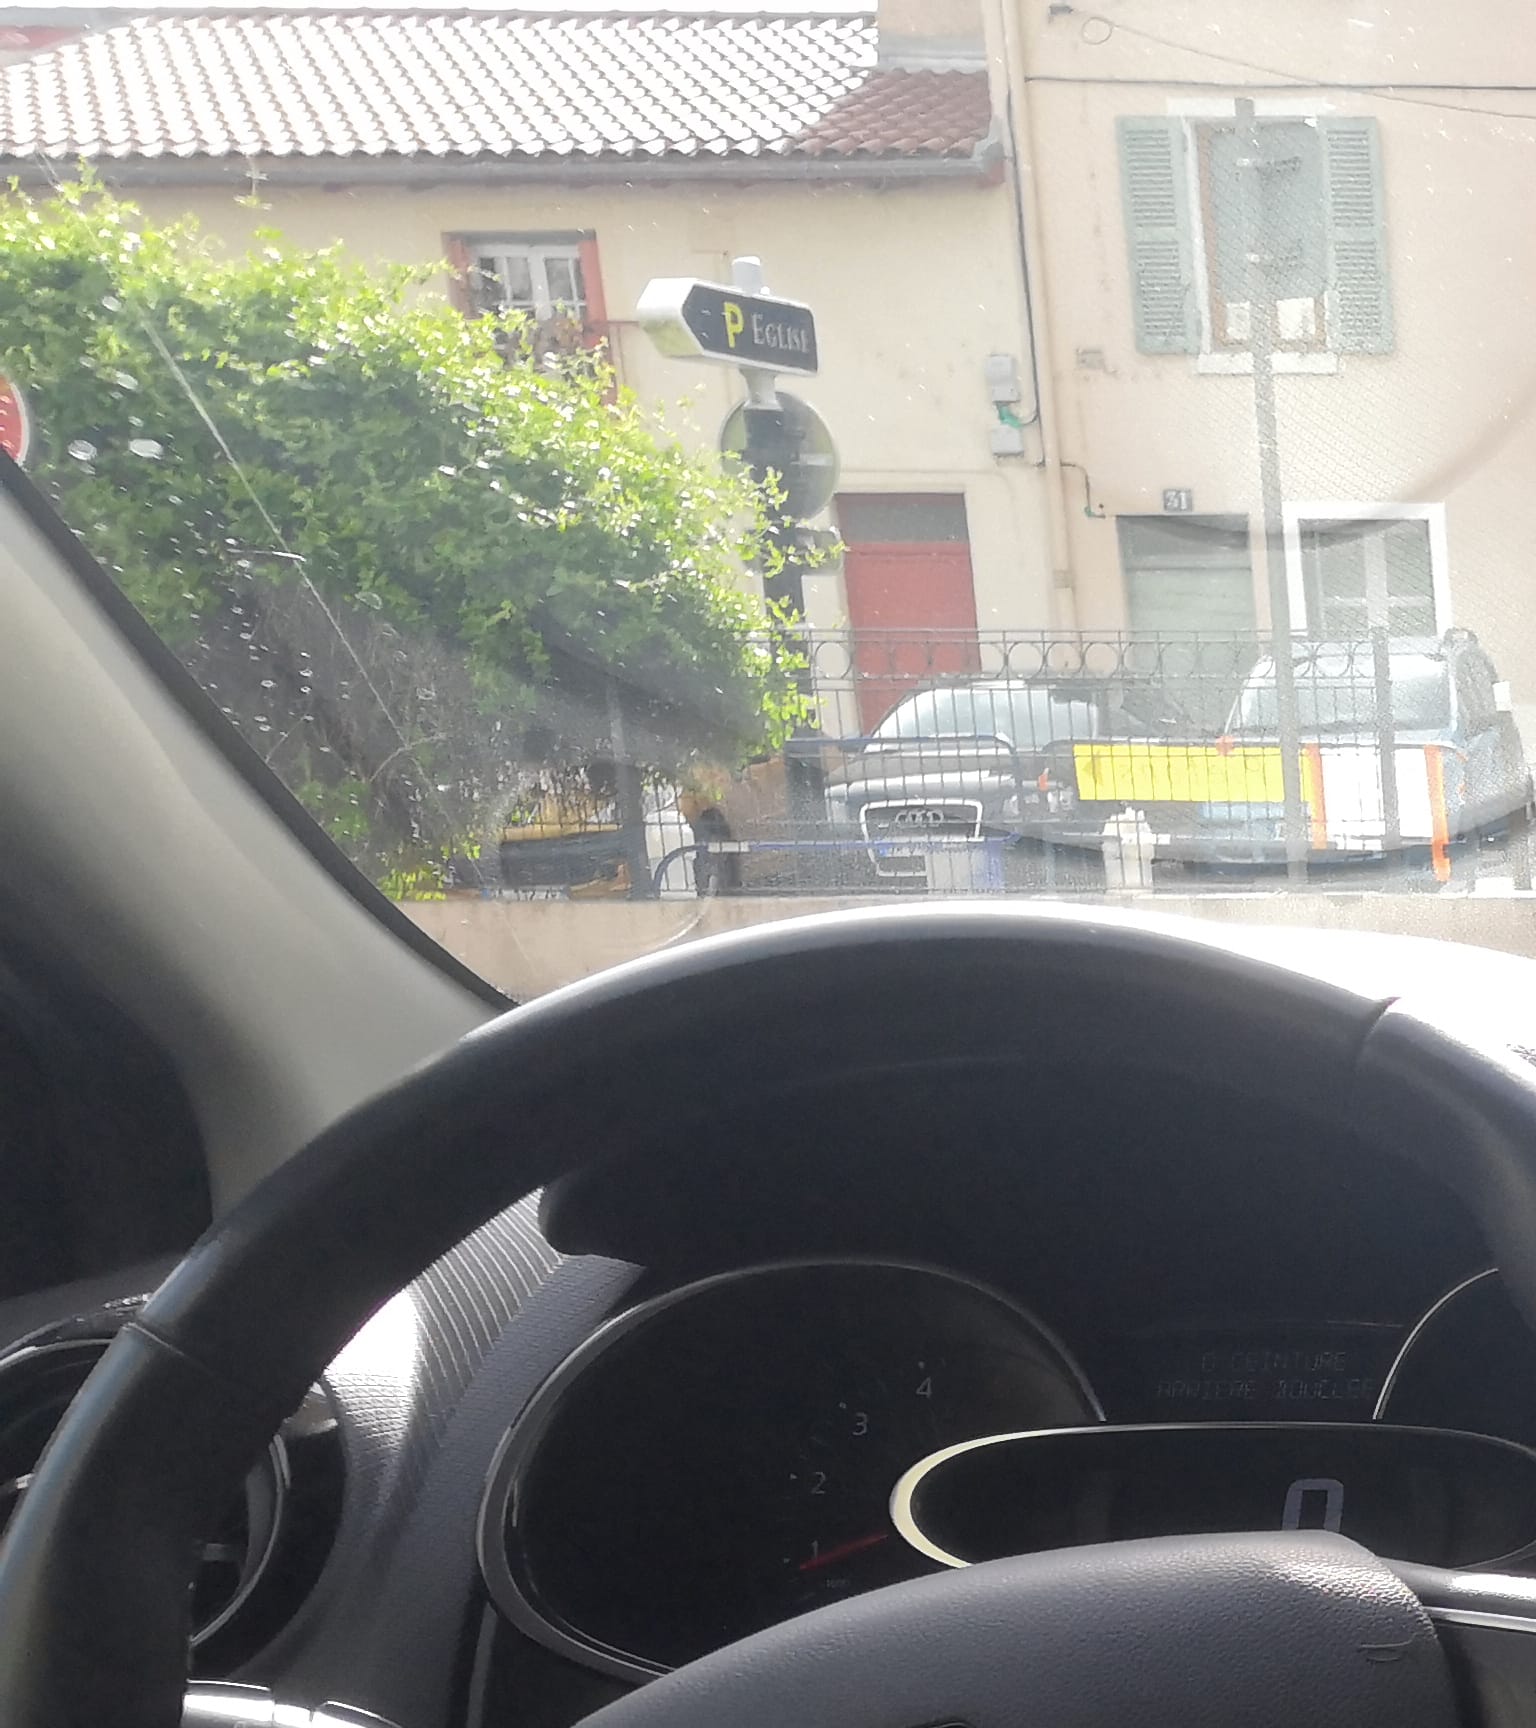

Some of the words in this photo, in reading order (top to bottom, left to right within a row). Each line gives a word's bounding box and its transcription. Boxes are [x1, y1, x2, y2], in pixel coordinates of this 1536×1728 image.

[724, 301, 744, 349] P
[853, 1412, 869, 1436] 3
[812, 1471, 828, 1495] 2
